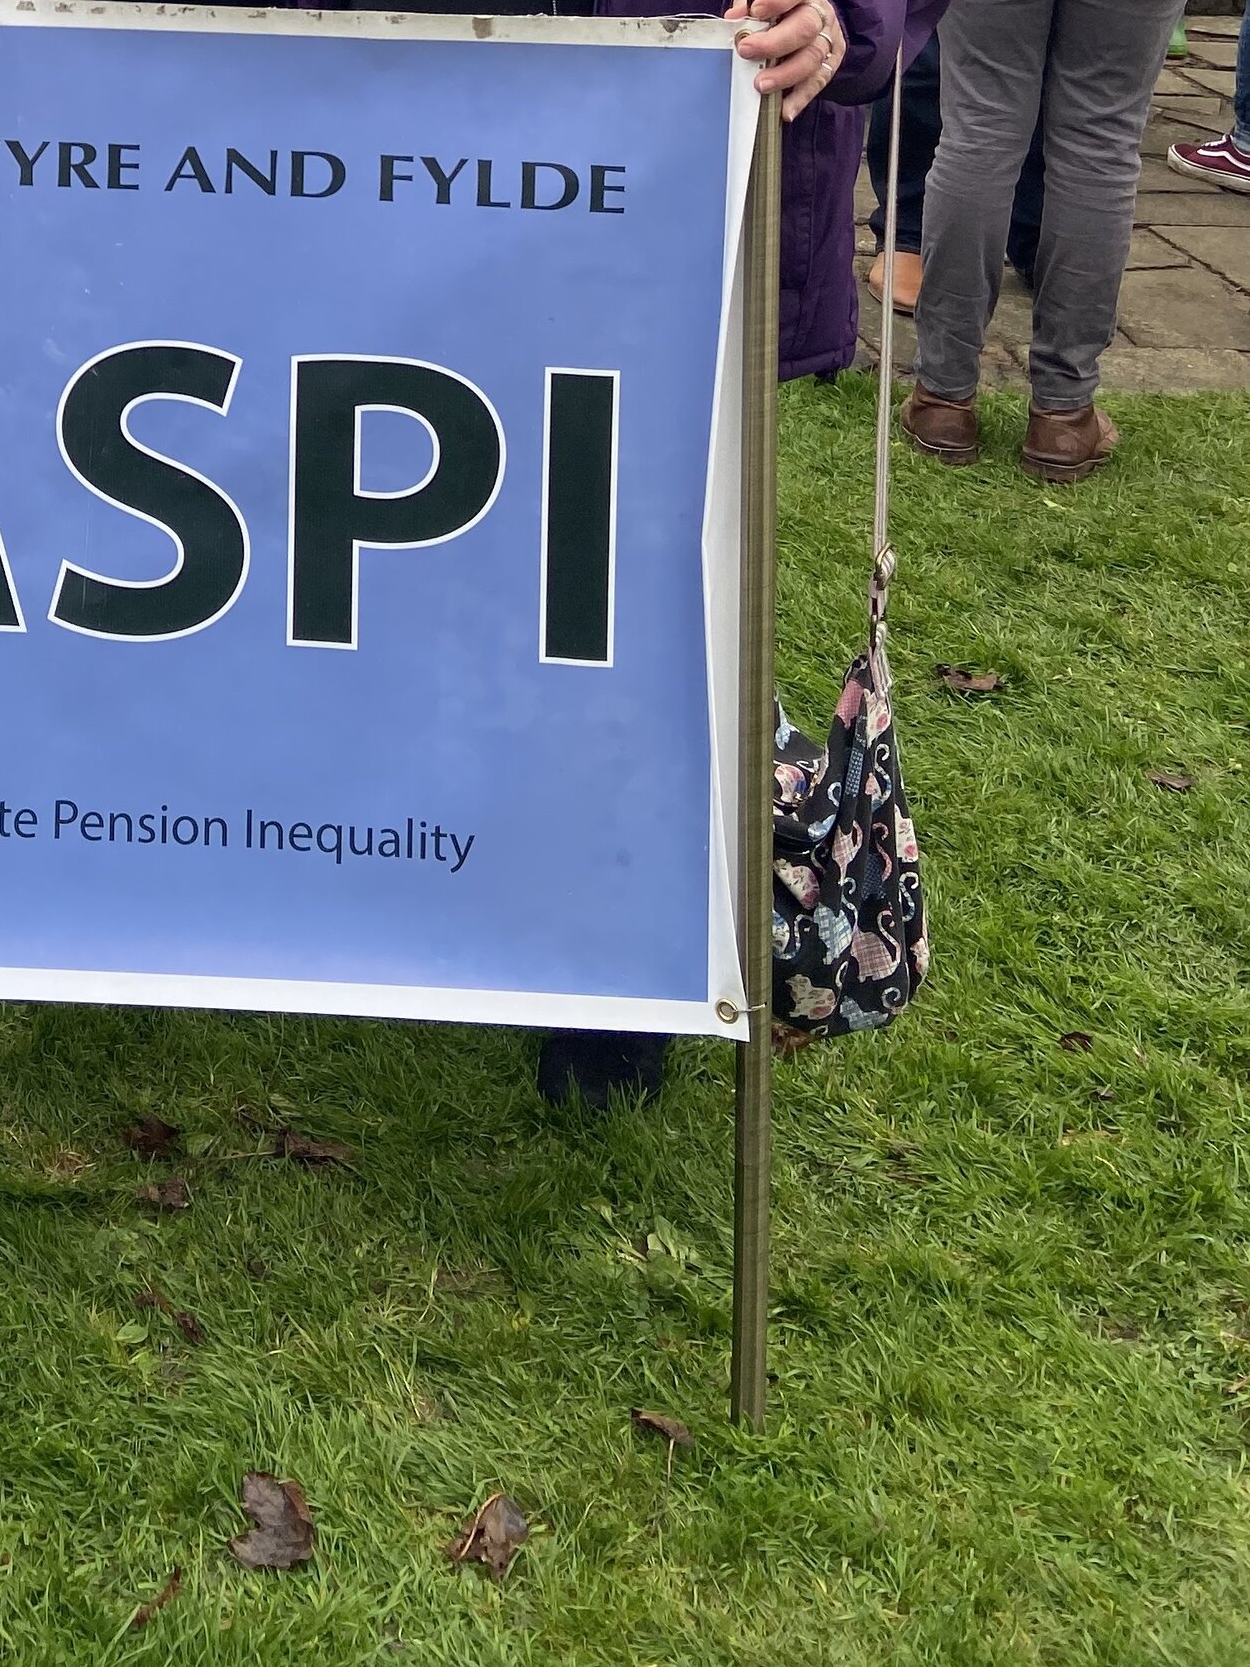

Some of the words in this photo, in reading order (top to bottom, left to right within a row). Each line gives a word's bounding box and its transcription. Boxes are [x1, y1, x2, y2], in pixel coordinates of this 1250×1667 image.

[165, 146, 346, 198] AND
[379, 154, 626, 214] FYLDE
[53, 799, 228, 847] Pension
[245, 809, 475, 873] Inequality
